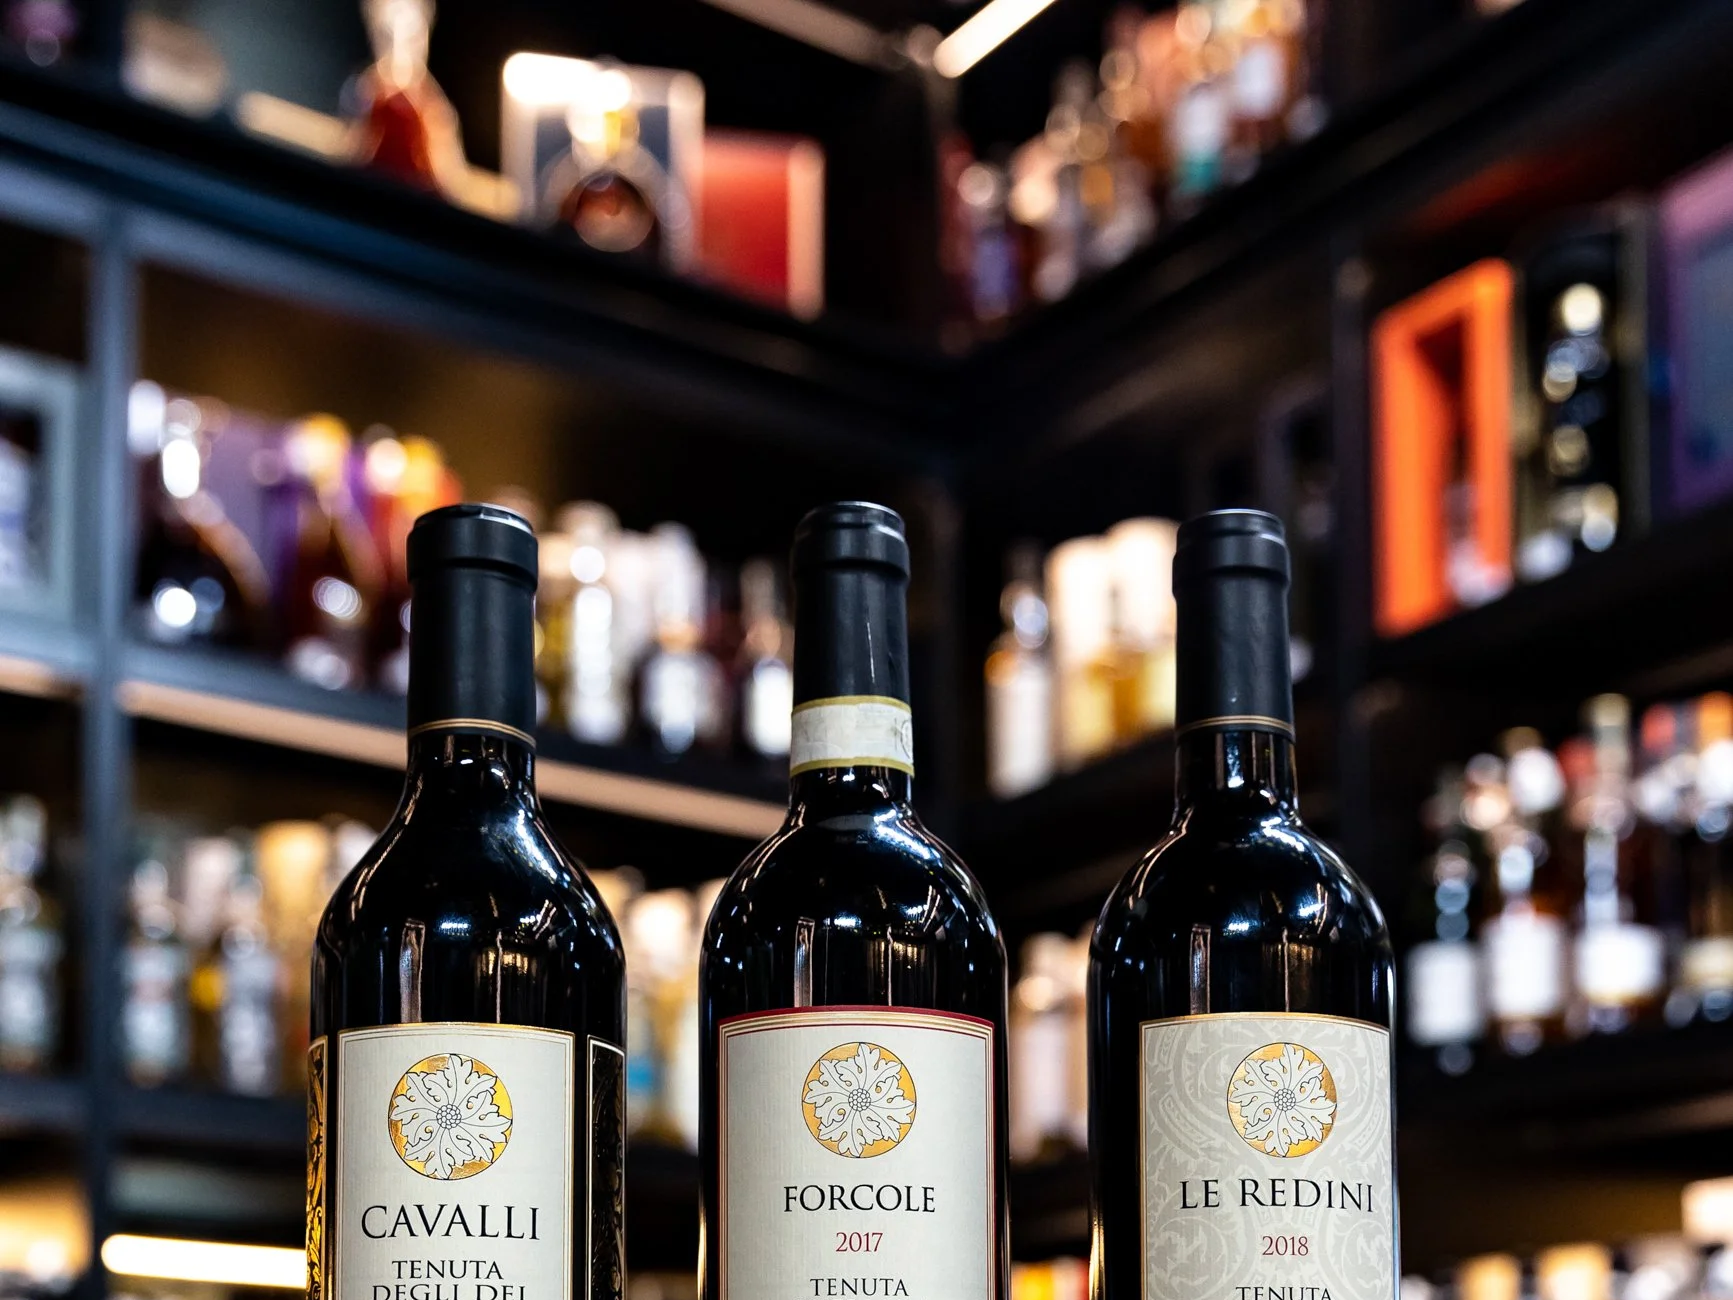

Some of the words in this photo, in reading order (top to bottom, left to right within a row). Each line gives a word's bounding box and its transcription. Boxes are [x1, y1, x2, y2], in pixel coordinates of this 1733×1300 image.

[783, 1184, 936, 1213] FORCOLE
[1179, 1178, 1220, 1209] LE
[1239, 1178, 1374, 1213] REDINI
[361, 1203, 540, 1240] CAVALLI
[835, 1232, 883, 1252] 2017
[1261, 1235, 1310, 1256] 2018
[391, 1260, 505, 1280] TENUTA
[810, 1278, 909, 1297] TENUTA
